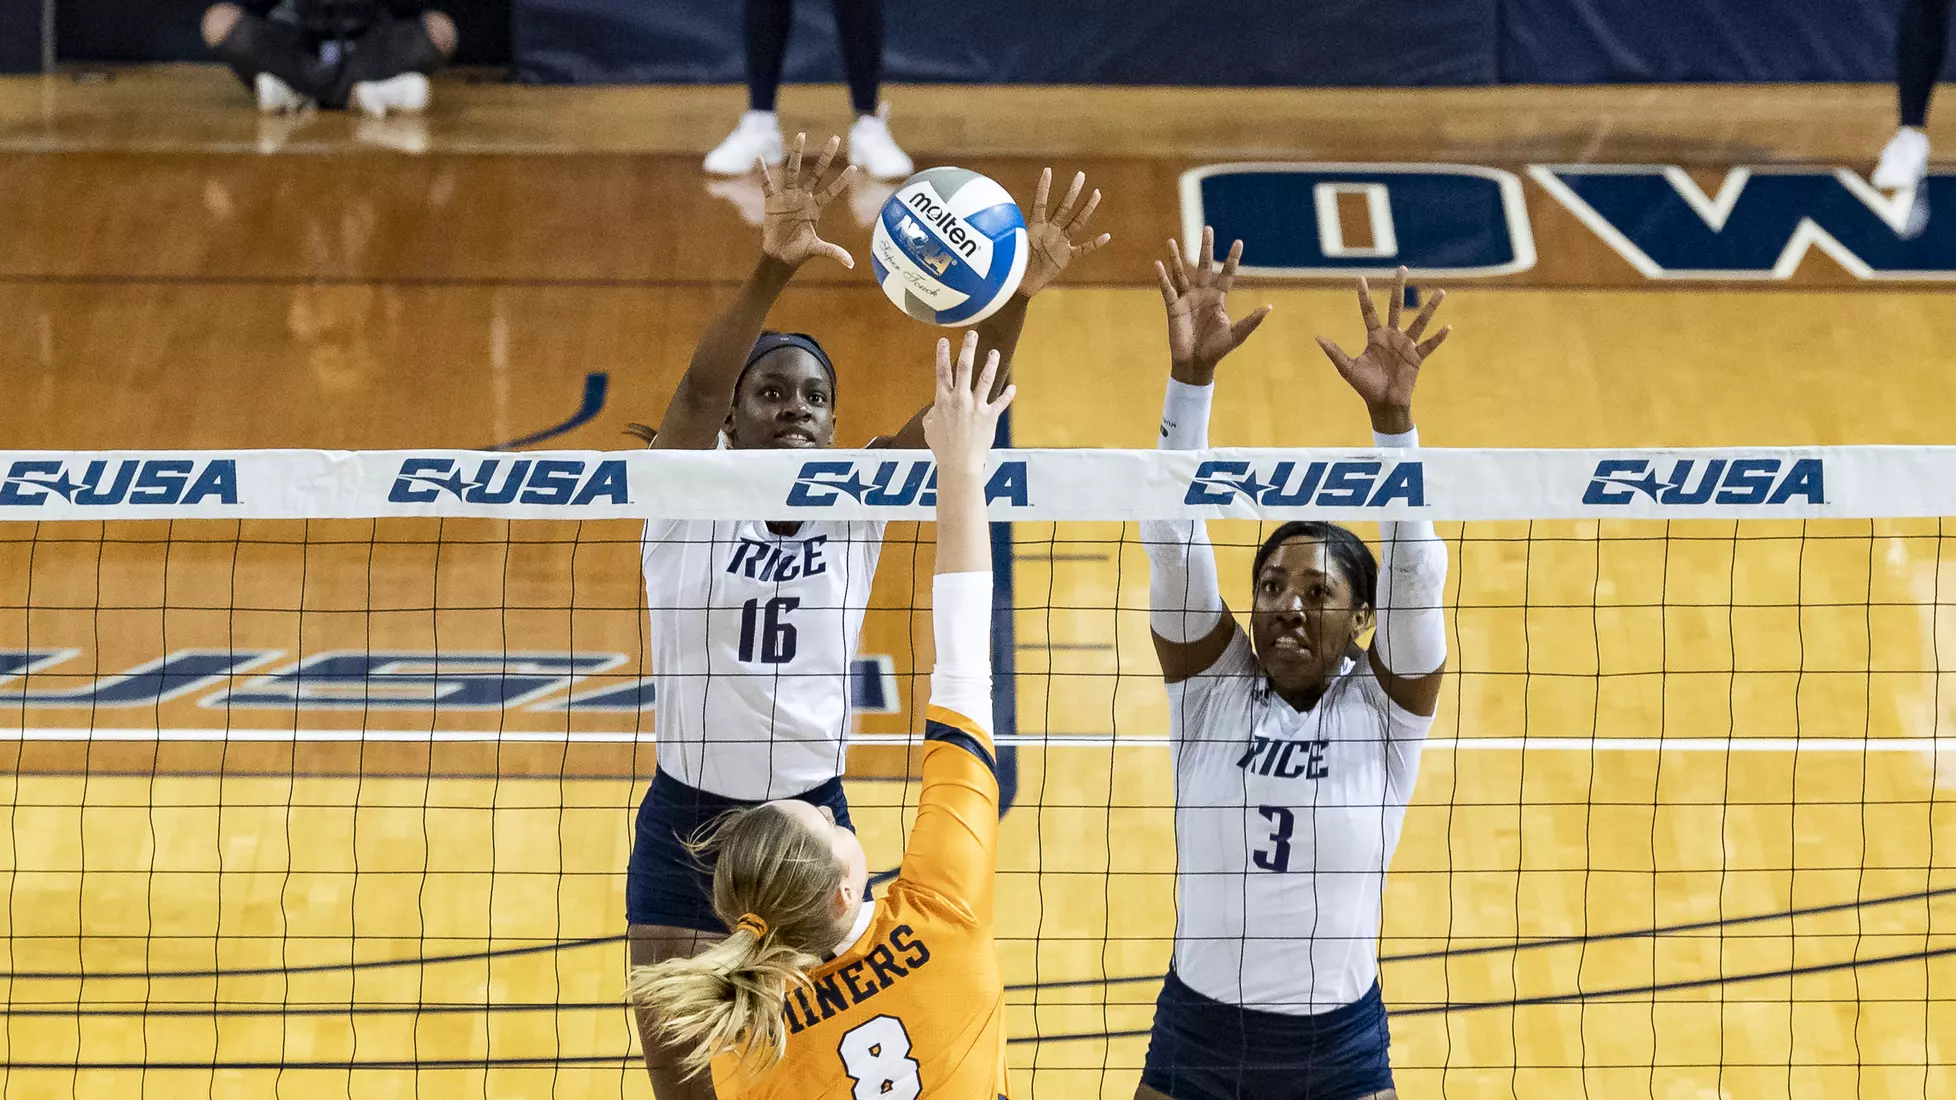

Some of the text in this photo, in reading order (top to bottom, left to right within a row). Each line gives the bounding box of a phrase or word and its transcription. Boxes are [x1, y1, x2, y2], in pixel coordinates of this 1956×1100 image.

[908, 192, 977, 258] molten
[880, 240, 941, 298] Super Touch
[726, 534, 828, 582] RICE
[738, 597, 800, 664] 16
[1237, 735, 1330, 780] RICE
[1252, 805, 1295, 873] 3
[836, 1013, 923, 1100] 8
